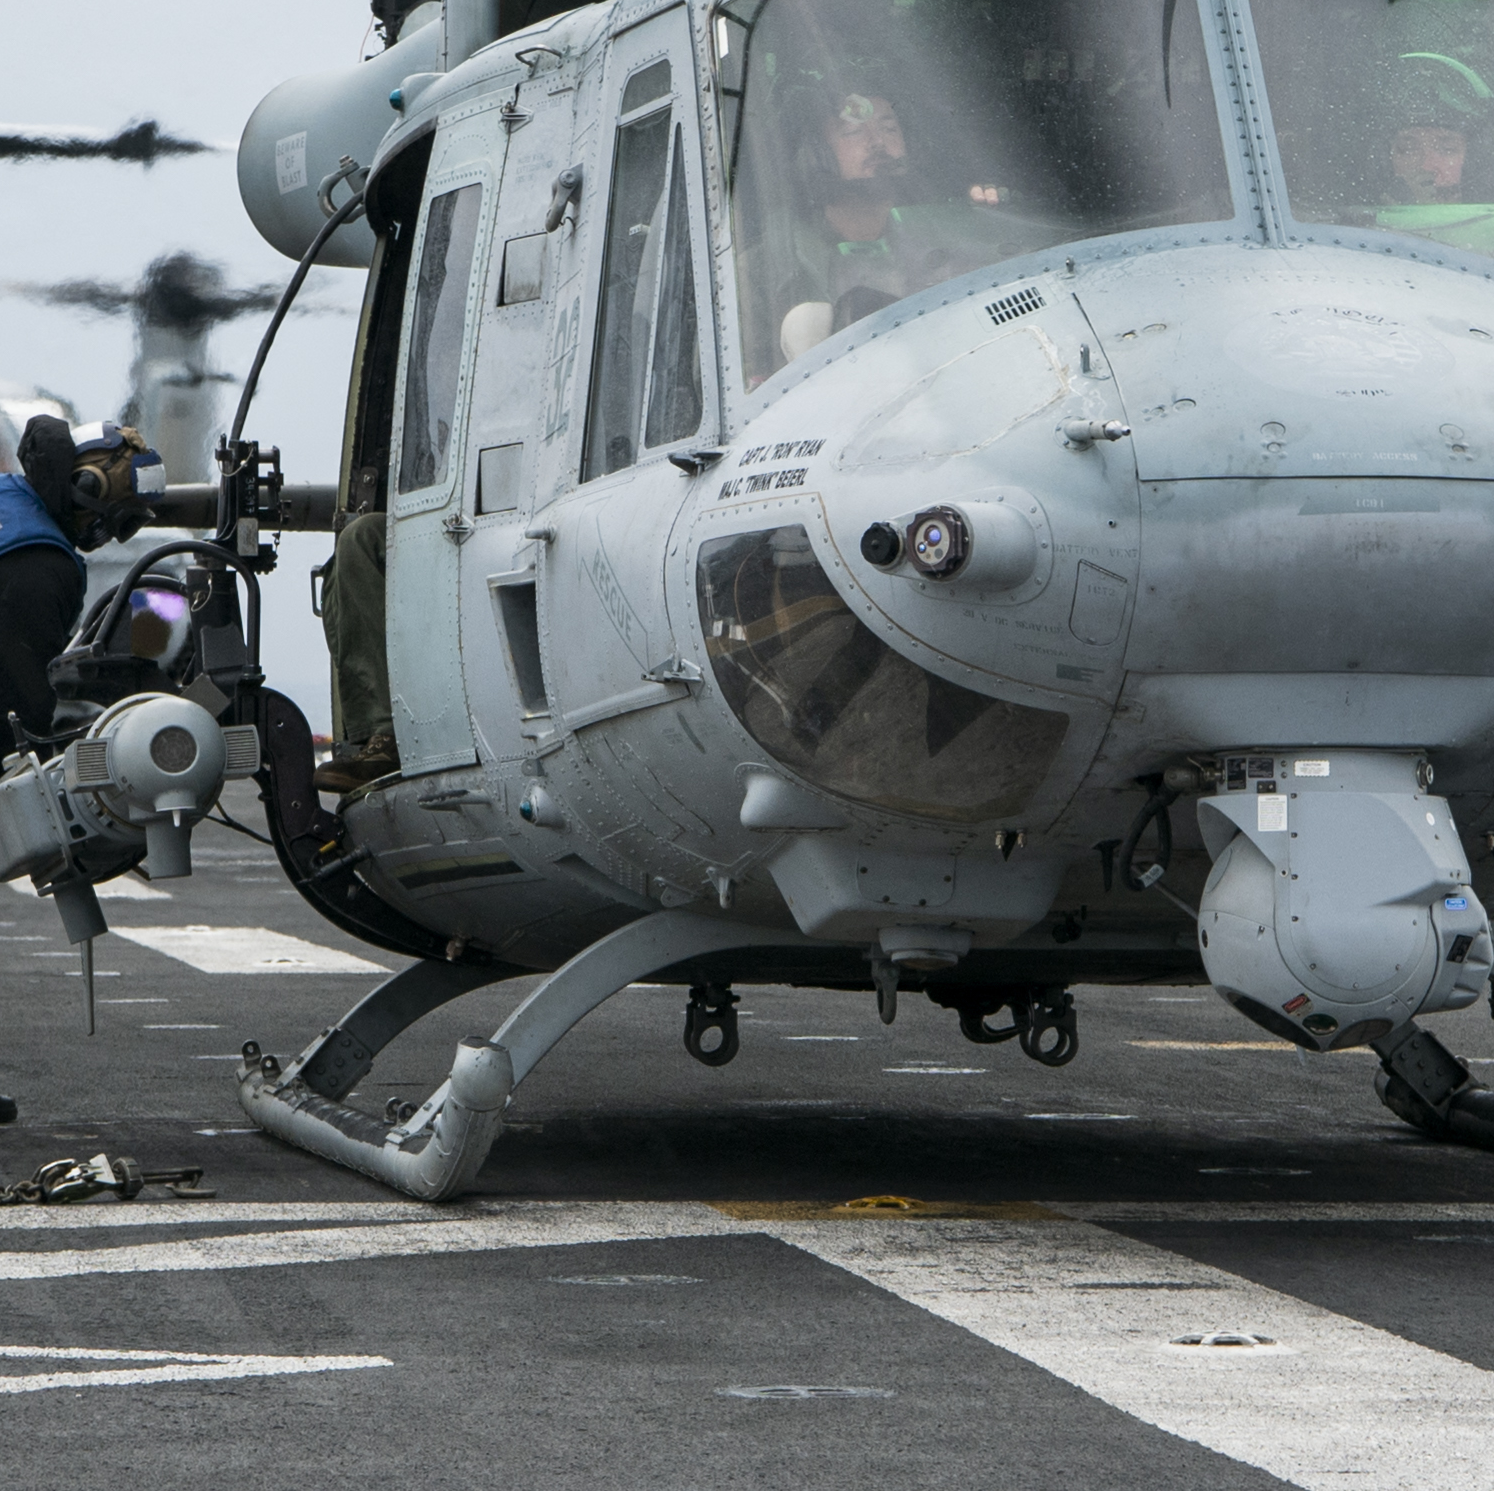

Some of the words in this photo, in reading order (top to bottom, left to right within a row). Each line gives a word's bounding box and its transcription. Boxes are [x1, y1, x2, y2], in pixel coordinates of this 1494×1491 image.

[276, 136, 305, 157] BEWARE
[285, 155, 294, 170] OF
[281, 170, 302, 188] BLAST
[738, 446, 766, 468] CAPT
[794, 438, 827, 458] RYAN
[1372, 452, 1418, 461] ACCESS
[1108, 547, 1138, 559] VENT
[592, 547, 632, 642] RESCUE
